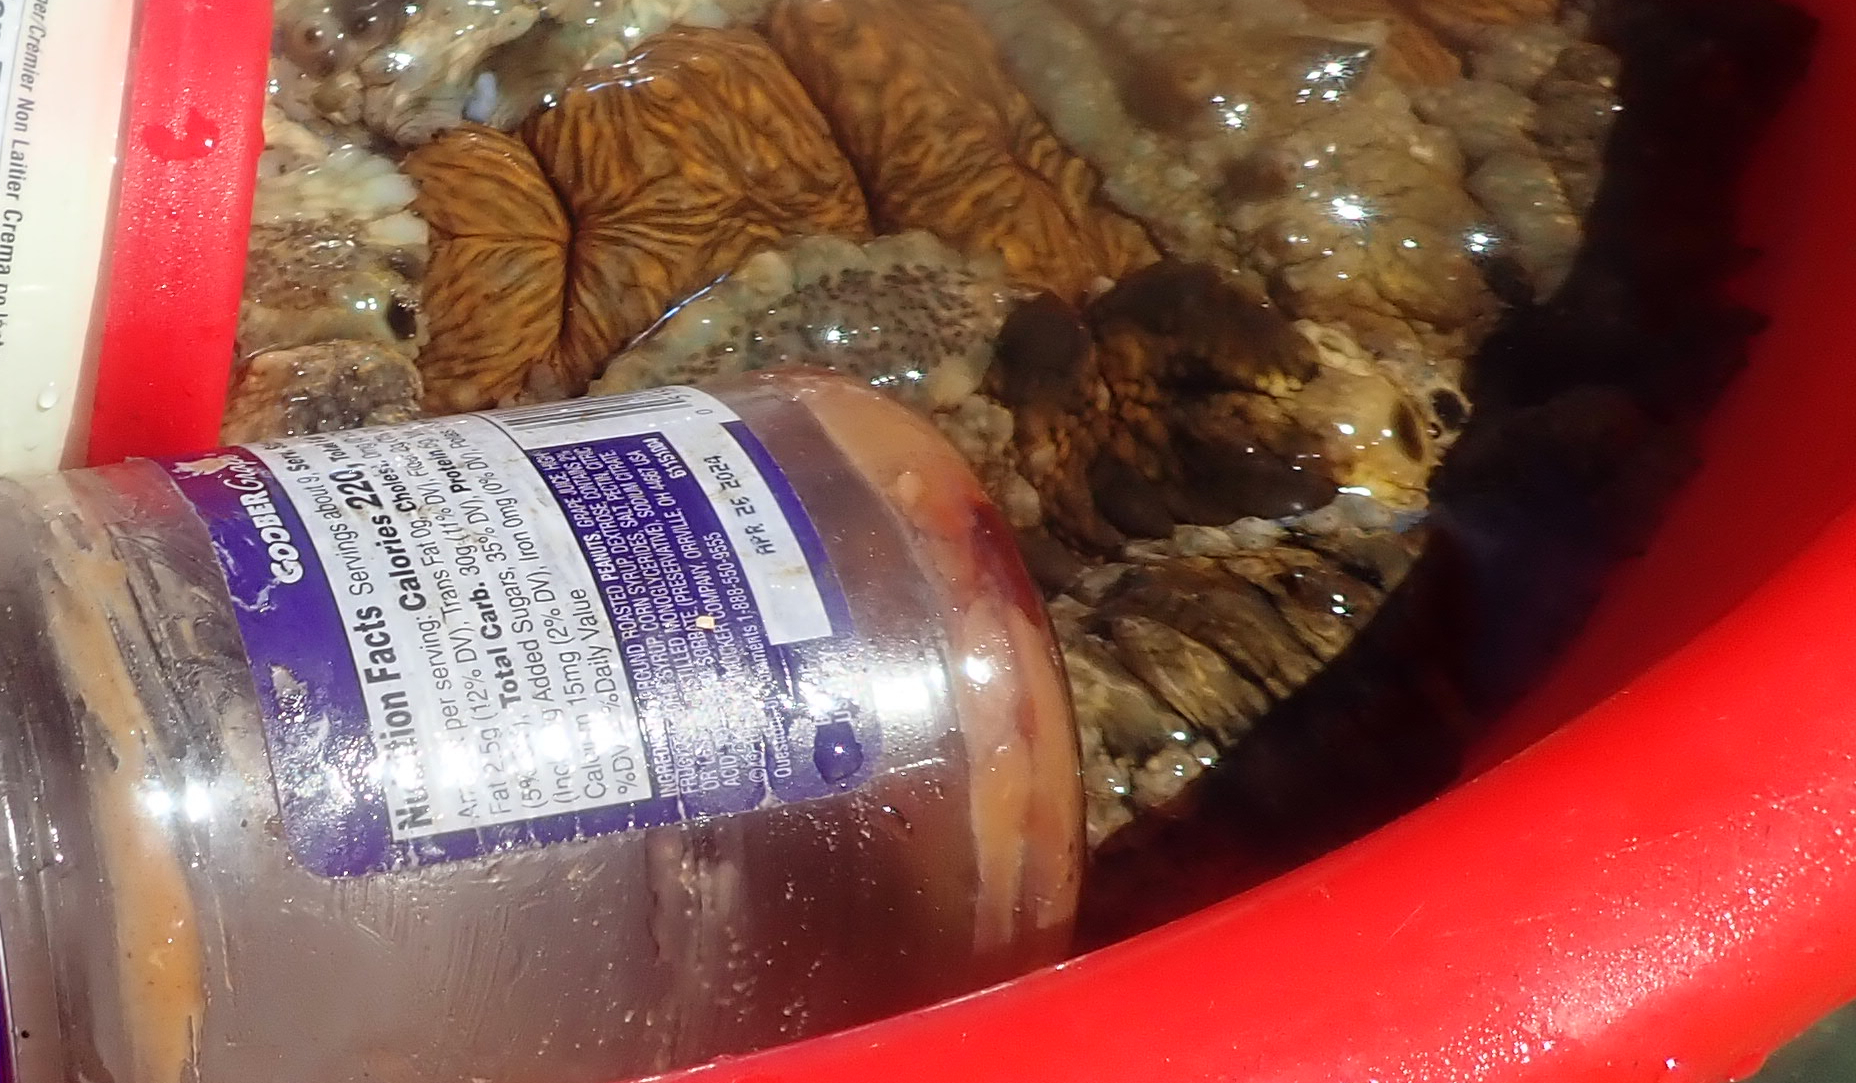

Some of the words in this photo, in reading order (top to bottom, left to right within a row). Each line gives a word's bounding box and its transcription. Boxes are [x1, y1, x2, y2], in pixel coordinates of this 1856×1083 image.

[13, 97, 35, 132] Non
[5, 139, 31, 200] Laitier
[425, 448, 472, 493] Protein
[626, 449, 650, 465] USA
[703, 454, 740, 489] 2024
[327, 462, 383, 513] 220,
[473, 471, 511, 496] (0%
[564, 461, 602, 499] CONTAINS
[621, 481, 655, 517] SODIUM
[655, 492, 676, 506] OH
[303, 484, 343, 519] about
[457, 495, 489, 524] DV),
[493, 496, 523, 528] 0mg
[562, 496, 595, 528] GRAPE
[610, 504, 638, 527] SALT,
[729, 496, 755, 515] 26
[238, 490, 304, 586] GOOBER
[432, 506, 469, 541] (11%
[589, 501, 628, 553] DEXTROSE,
[663, 506, 703, 559] ORRVILLE,
[743, 522, 777, 556] APR
[327, 521, 374, 596] Servings
[368, 514, 428, 612] Calories
[414, 541, 443, 566] Fat
[450, 543, 480, 577] 30g
[474, 525, 507, 563] 35%
[510, 531, 539, 561] Iron
[581, 530, 619, 582] PEANUTS,
[427, 569, 463, 618] Trans
[523, 565, 556, 603] DV),
[612, 556, 645, 593] SYRUP,
[688, 562, 725, 619] COMPANY,
[463, 581, 502, 640] Carb.
[491, 566, 534, 634] Sugars,
[565, 587, 600, 640] Value
[604, 583, 636, 640] ROASTED
[631, 596, 658, 630] CORN
[350, 605, 401, 684] Facts
[445, 620, 477, 663] DV),
[539, 607, 574, 645] (2%
[413, 613, 453, 690] serving:
[486, 647, 522, 709] Total
[517, 639, 554, 703] Added
[556, 650, 587, 706] 15mg
[583, 642, 621, 712] %Daily
[438, 695, 467, 730] per
[459, 667, 497, 720] (12%
[483, 781, 511, 815] Fat
